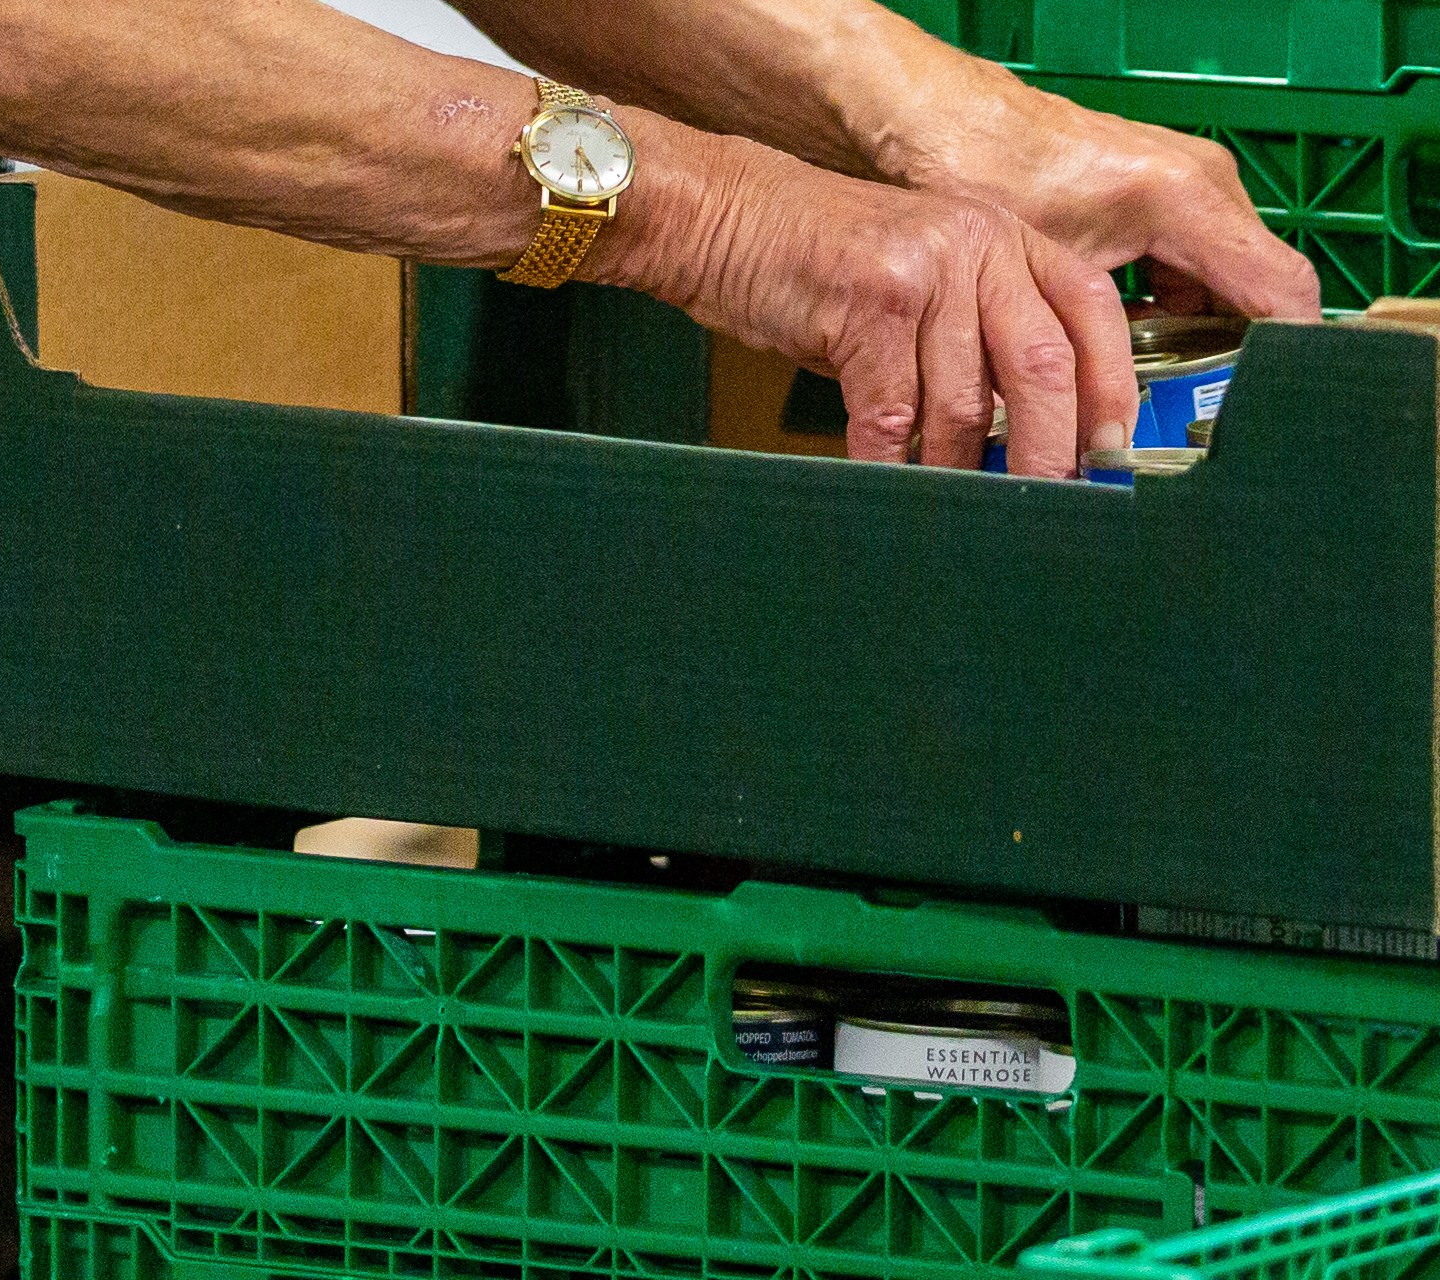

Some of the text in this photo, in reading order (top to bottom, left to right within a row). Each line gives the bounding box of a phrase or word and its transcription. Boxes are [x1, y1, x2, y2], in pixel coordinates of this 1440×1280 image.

[735, 1031, 772, 1044] HOPPED
[753, 1049, 788, 1064] chopped
[926, 1047, 1031, 1065] ESSENTIAL
[926, 1065, 1031, 1082] WAITROSE
